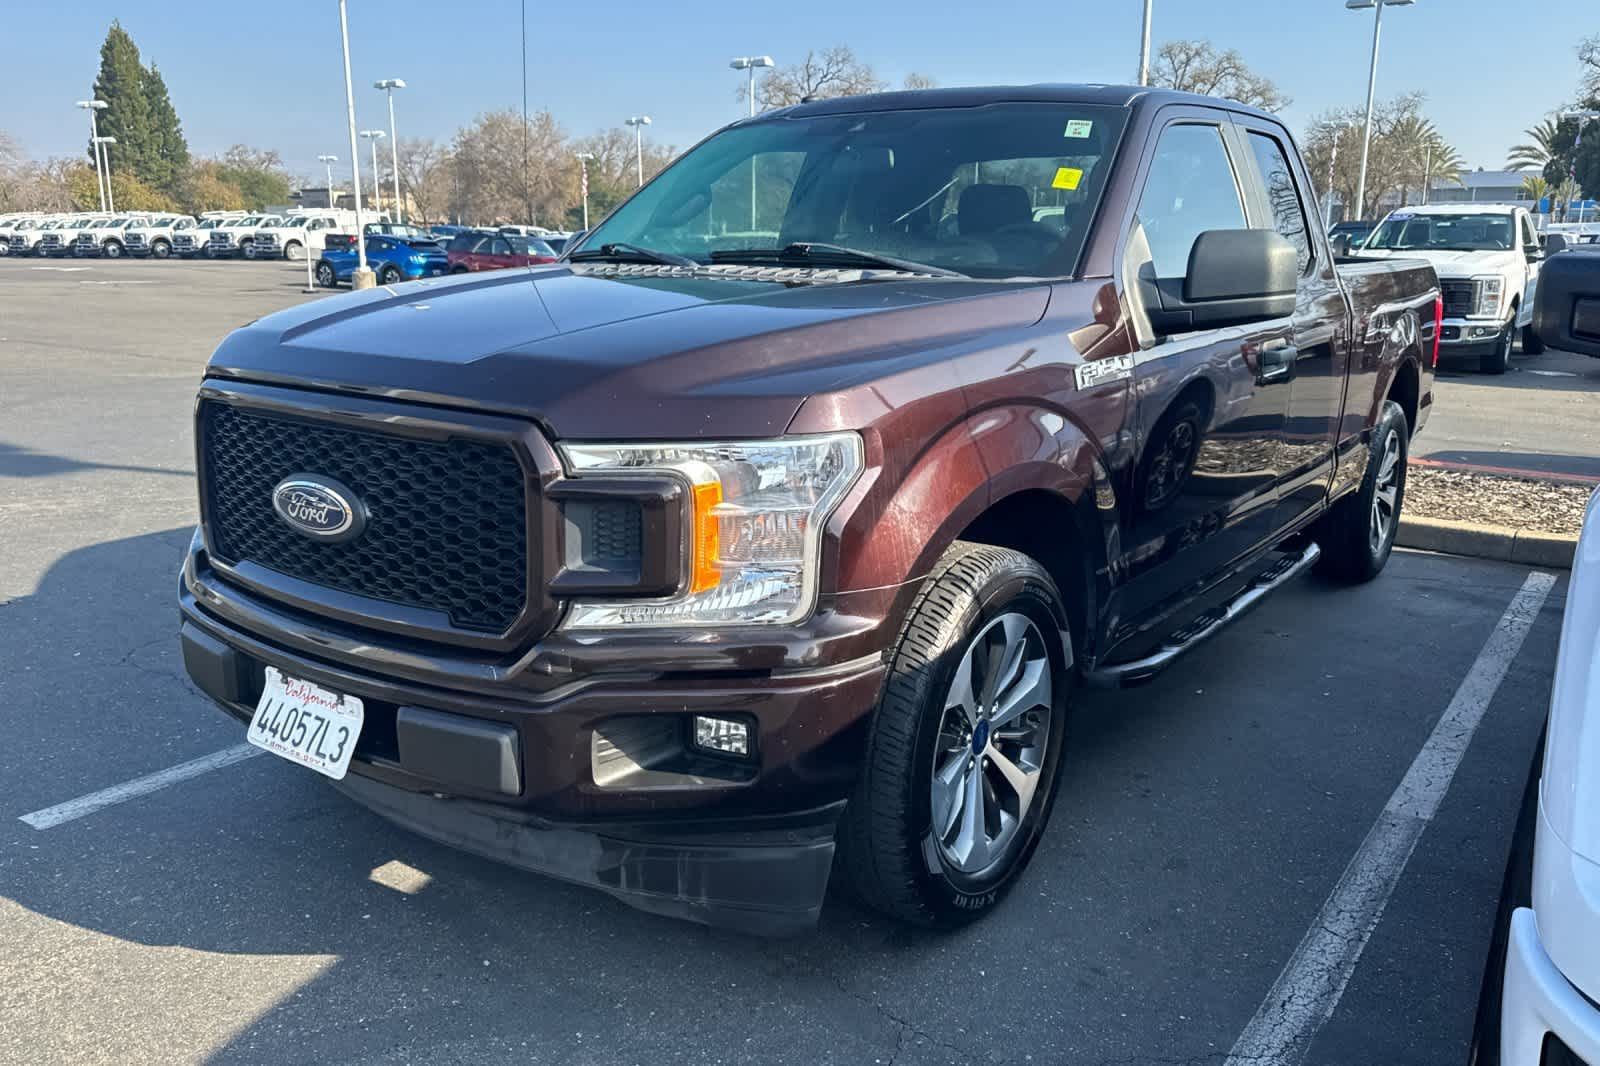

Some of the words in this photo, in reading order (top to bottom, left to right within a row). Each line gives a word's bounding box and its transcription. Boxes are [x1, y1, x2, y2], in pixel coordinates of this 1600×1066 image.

[288, 491, 329, 524] Ford
[285, 680, 338, 710] California
[257, 698, 350, 763] 44057L3
